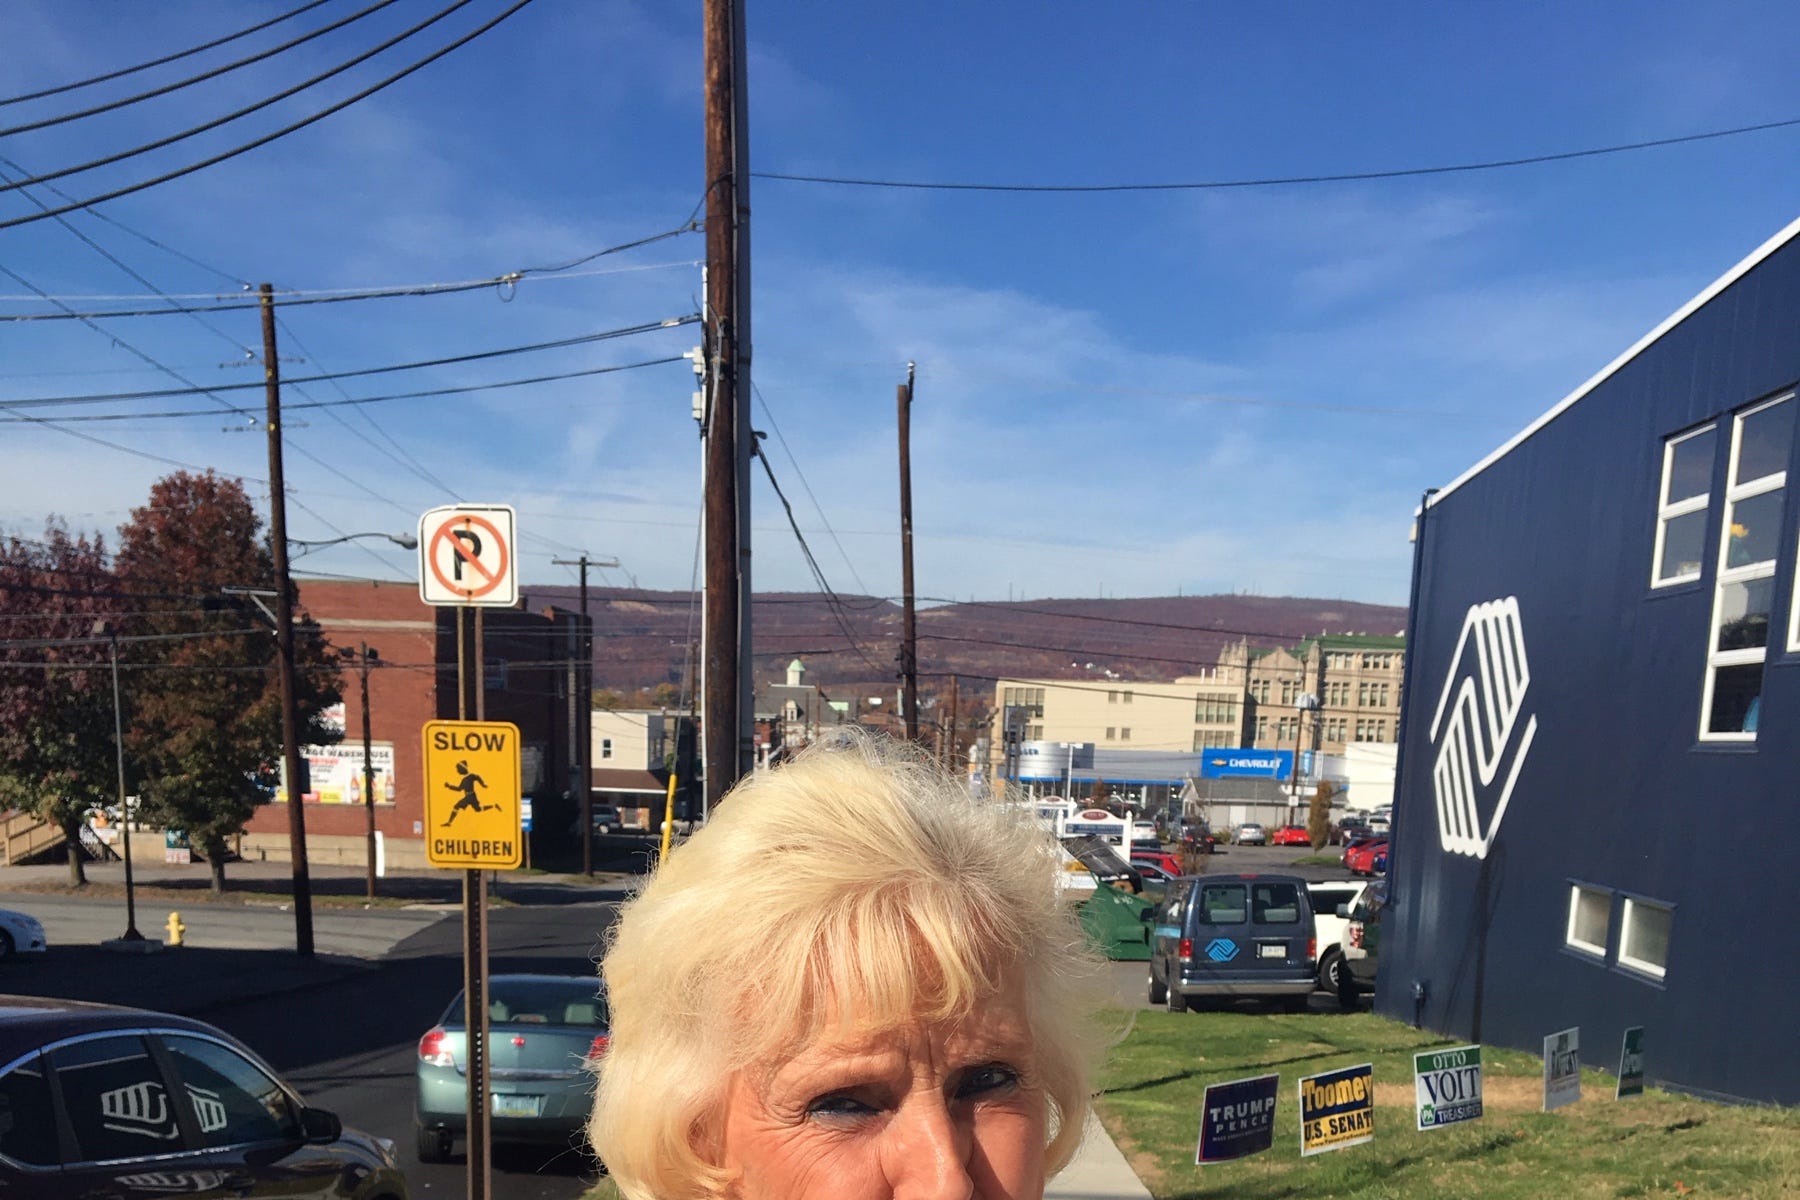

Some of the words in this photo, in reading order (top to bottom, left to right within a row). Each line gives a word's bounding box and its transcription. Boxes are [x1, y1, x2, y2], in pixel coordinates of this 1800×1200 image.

[453, 530, 482, 581] P
[434, 731, 505, 752] SLOW
[328, 747, 389, 758] WAREHUSE
[1229, 758, 1282, 768] CHEVROLET
[434, 839, 512, 857] CHILDREN
[1433, 1051, 1467, 1069] OTTO
[1302, 1074, 1372, 1112] Toomey
[1422, 1067, 1479, 1104] VOIT
[1209, 1097, 1275, 1123] TRUMP
[1423, 1109, 1434, 1120] PA
[1216, 1114, 1268, 1135] PENCE
[1304, 1121, 1327, 1141] U.S.
